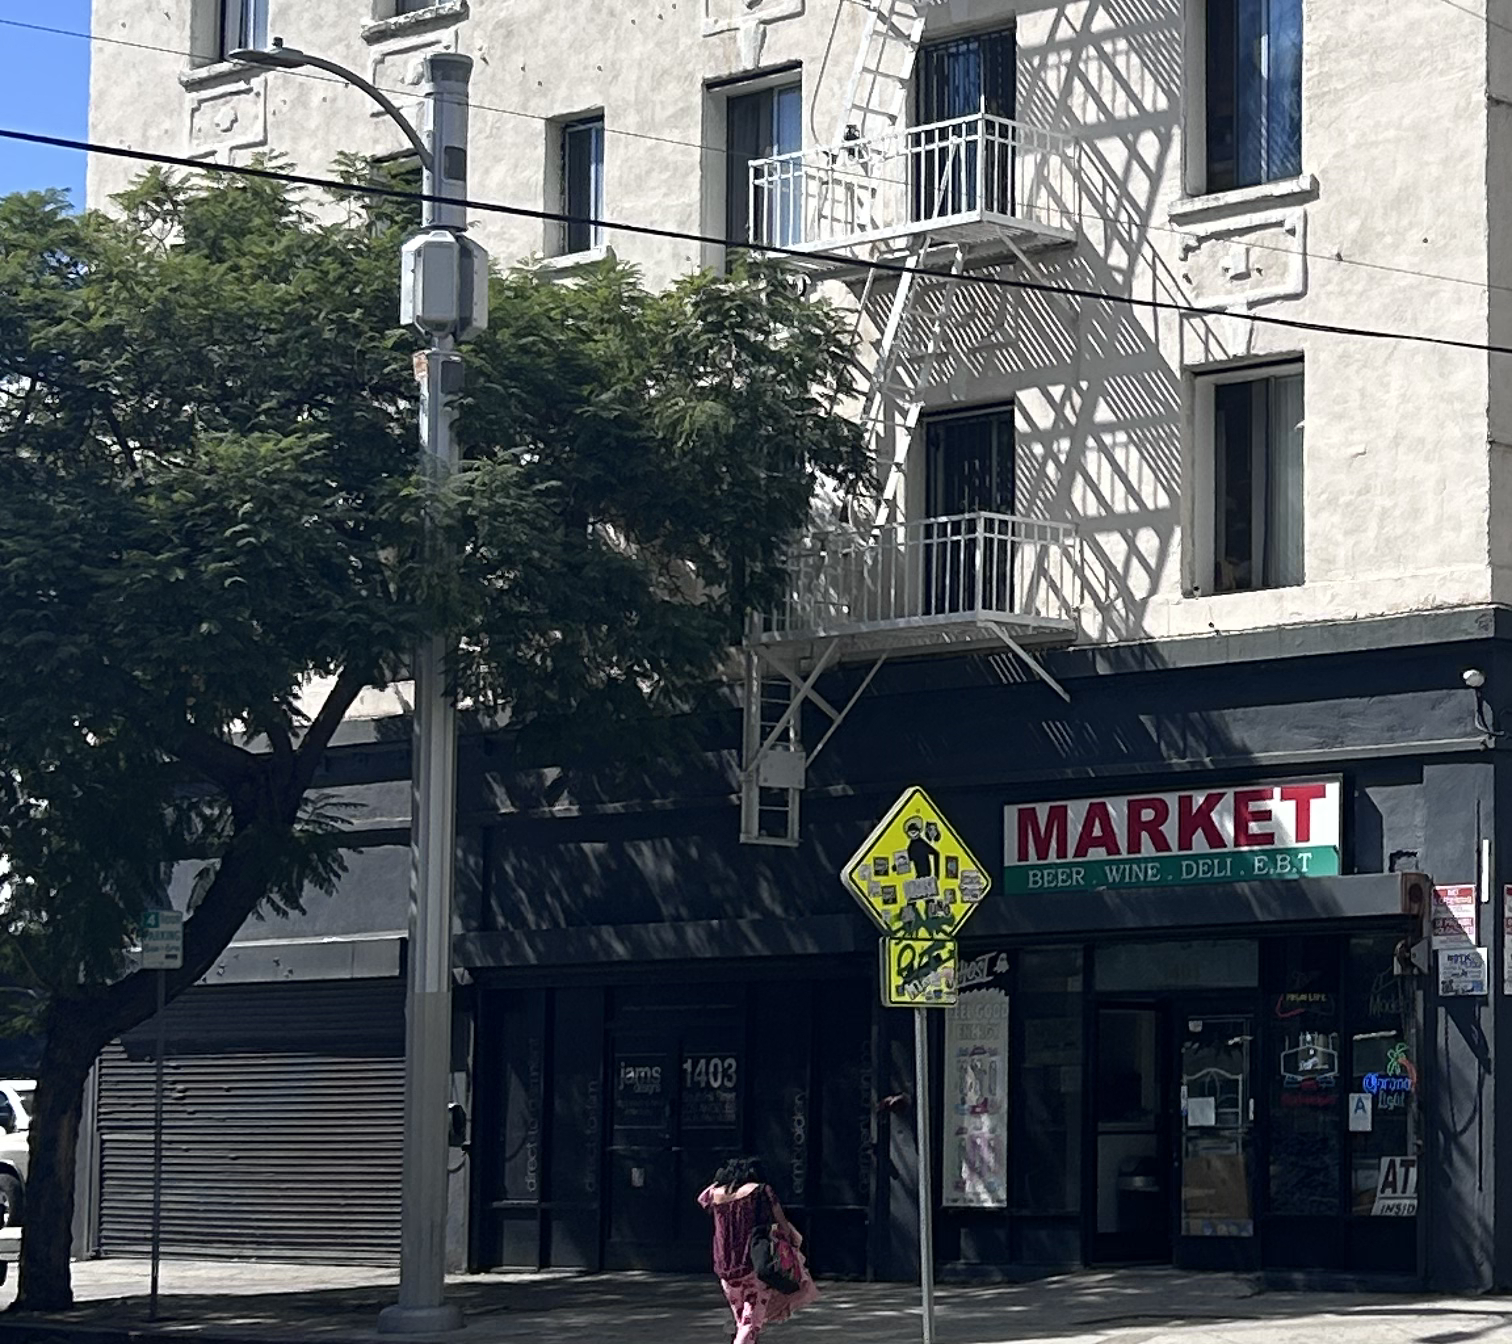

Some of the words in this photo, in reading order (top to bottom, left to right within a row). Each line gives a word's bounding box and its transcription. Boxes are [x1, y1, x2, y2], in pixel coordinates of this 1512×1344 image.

[1016, 784, 1327, 863] MARKET
[1027, 866, 1085, 889] BEER
[1104, 861, 1161, 884] WINE
[1180, 856, 1232, 879] DELI
[1252, 852, 1313, 876] E.B.T
[146, 914, 157, 927] 4
[618, 1061, 662, 1091] jams
[681, 1057, 738, 1089] 1403
[1353, 1096, 1368, 1115] A
[1380, 1158, 1416, 1195] AT
[1380, 1203, 1416, 1216] INSID
